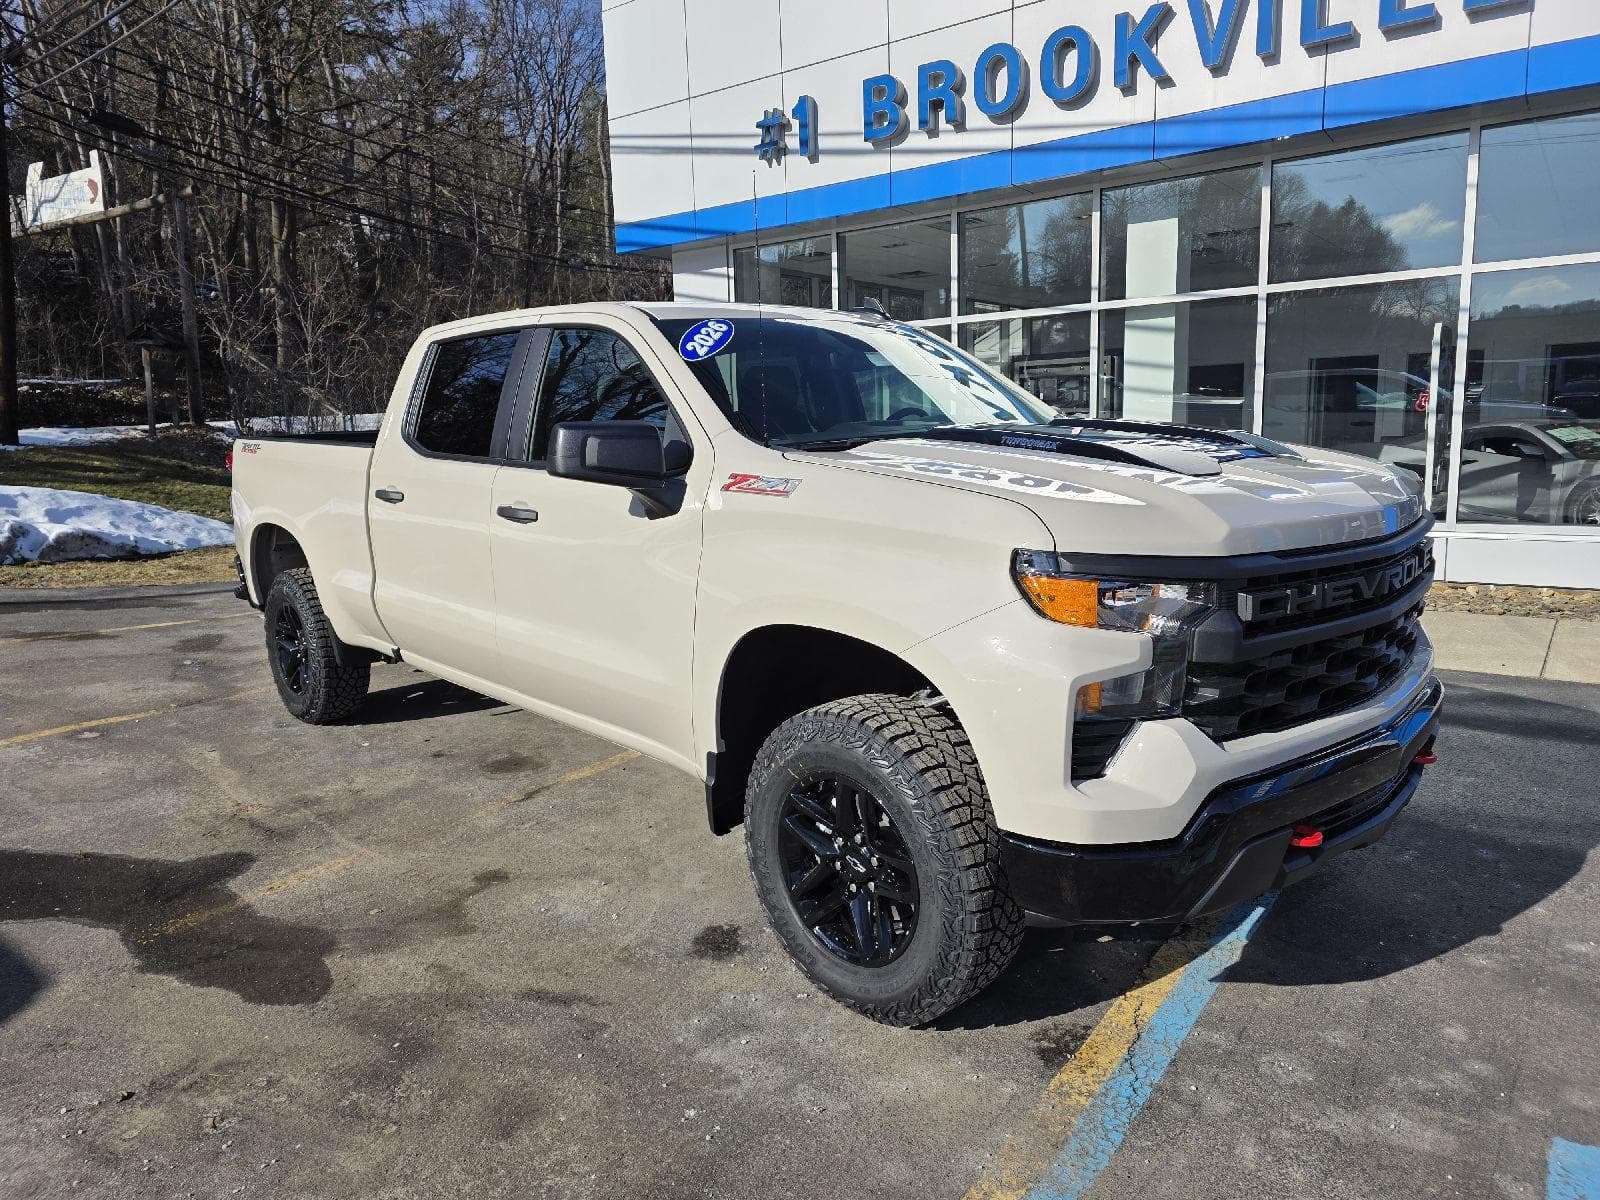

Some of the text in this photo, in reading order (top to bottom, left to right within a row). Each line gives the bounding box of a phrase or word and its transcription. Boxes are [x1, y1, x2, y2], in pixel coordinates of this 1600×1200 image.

[754, 0, 1531, 166] #1 BROOKVIL
[685, 320, 730, 357] 2026
[720, 472, 803, 498] Z71
[1238, 538, 1434, 622] CHEVROLE
